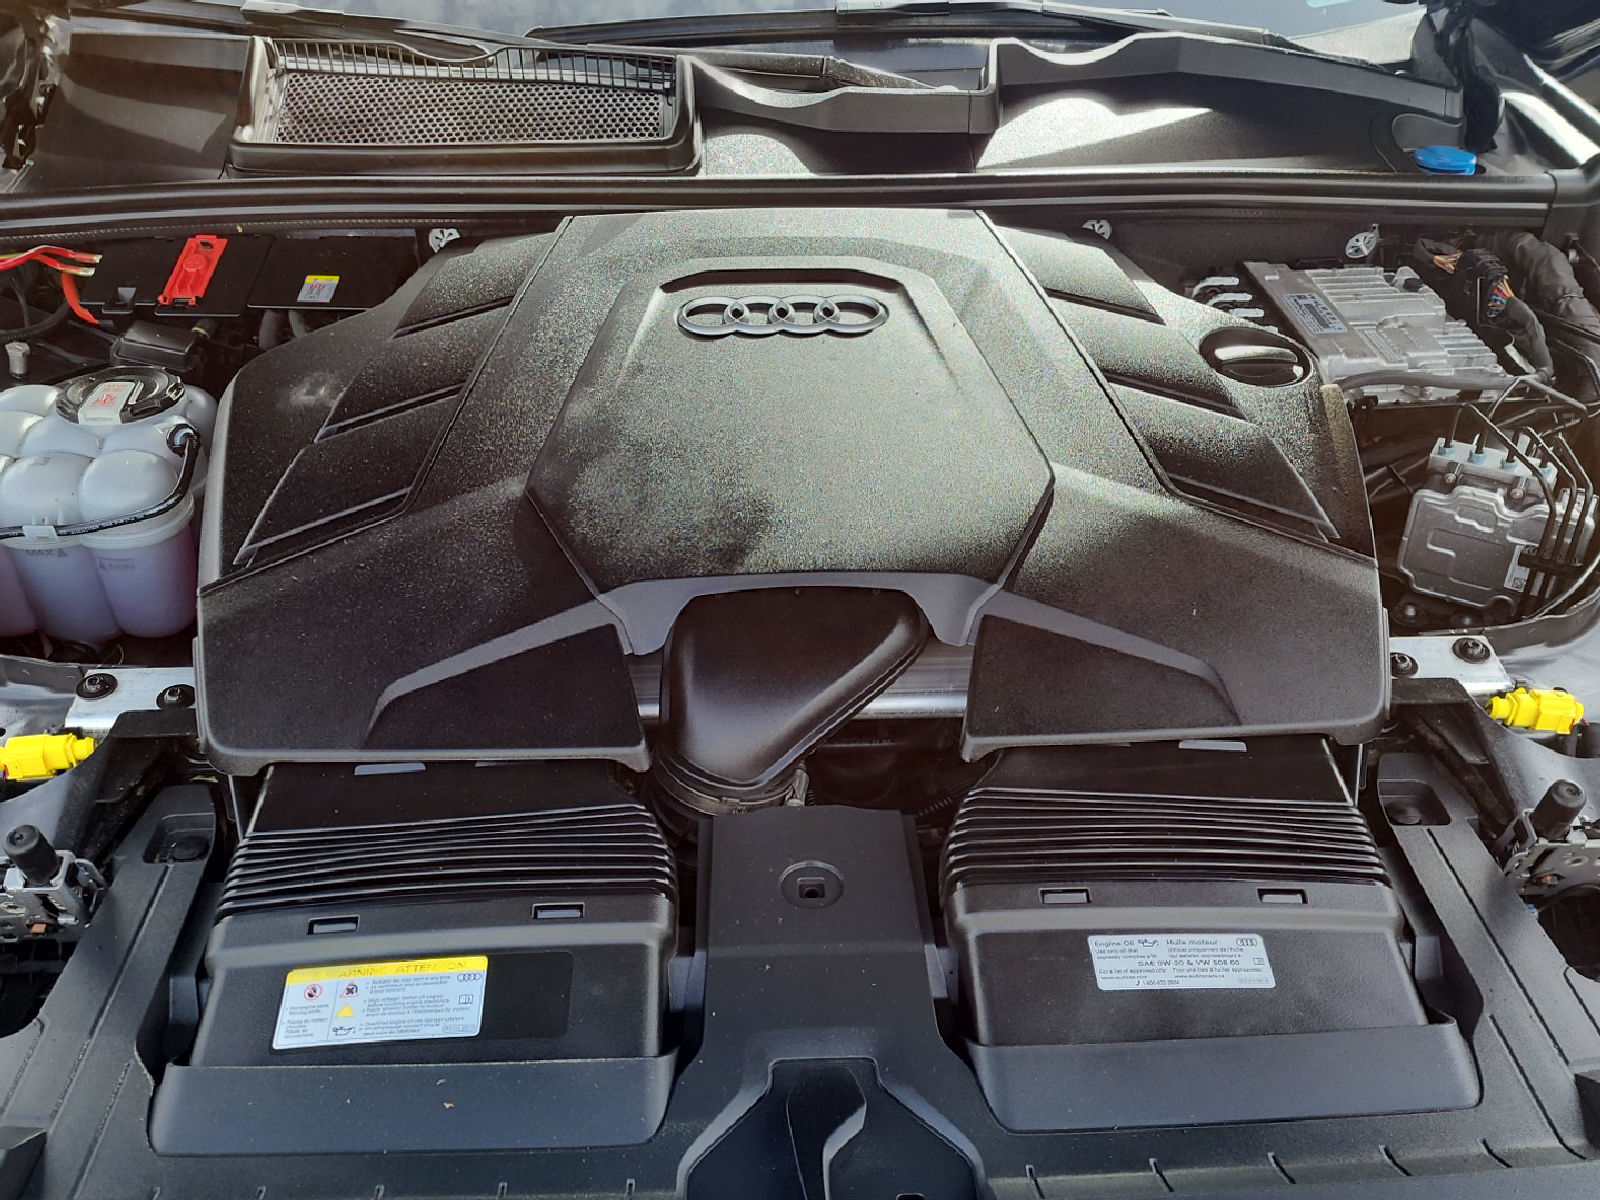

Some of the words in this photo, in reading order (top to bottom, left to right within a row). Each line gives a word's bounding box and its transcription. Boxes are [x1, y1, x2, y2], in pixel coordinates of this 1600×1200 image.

[24, 548, 56, 557] MAX
[1094, 940, 1122, 948] Engine
[1123, 939, 1135, 947] Oil
[1166, 938, 1186, 946] Huile
